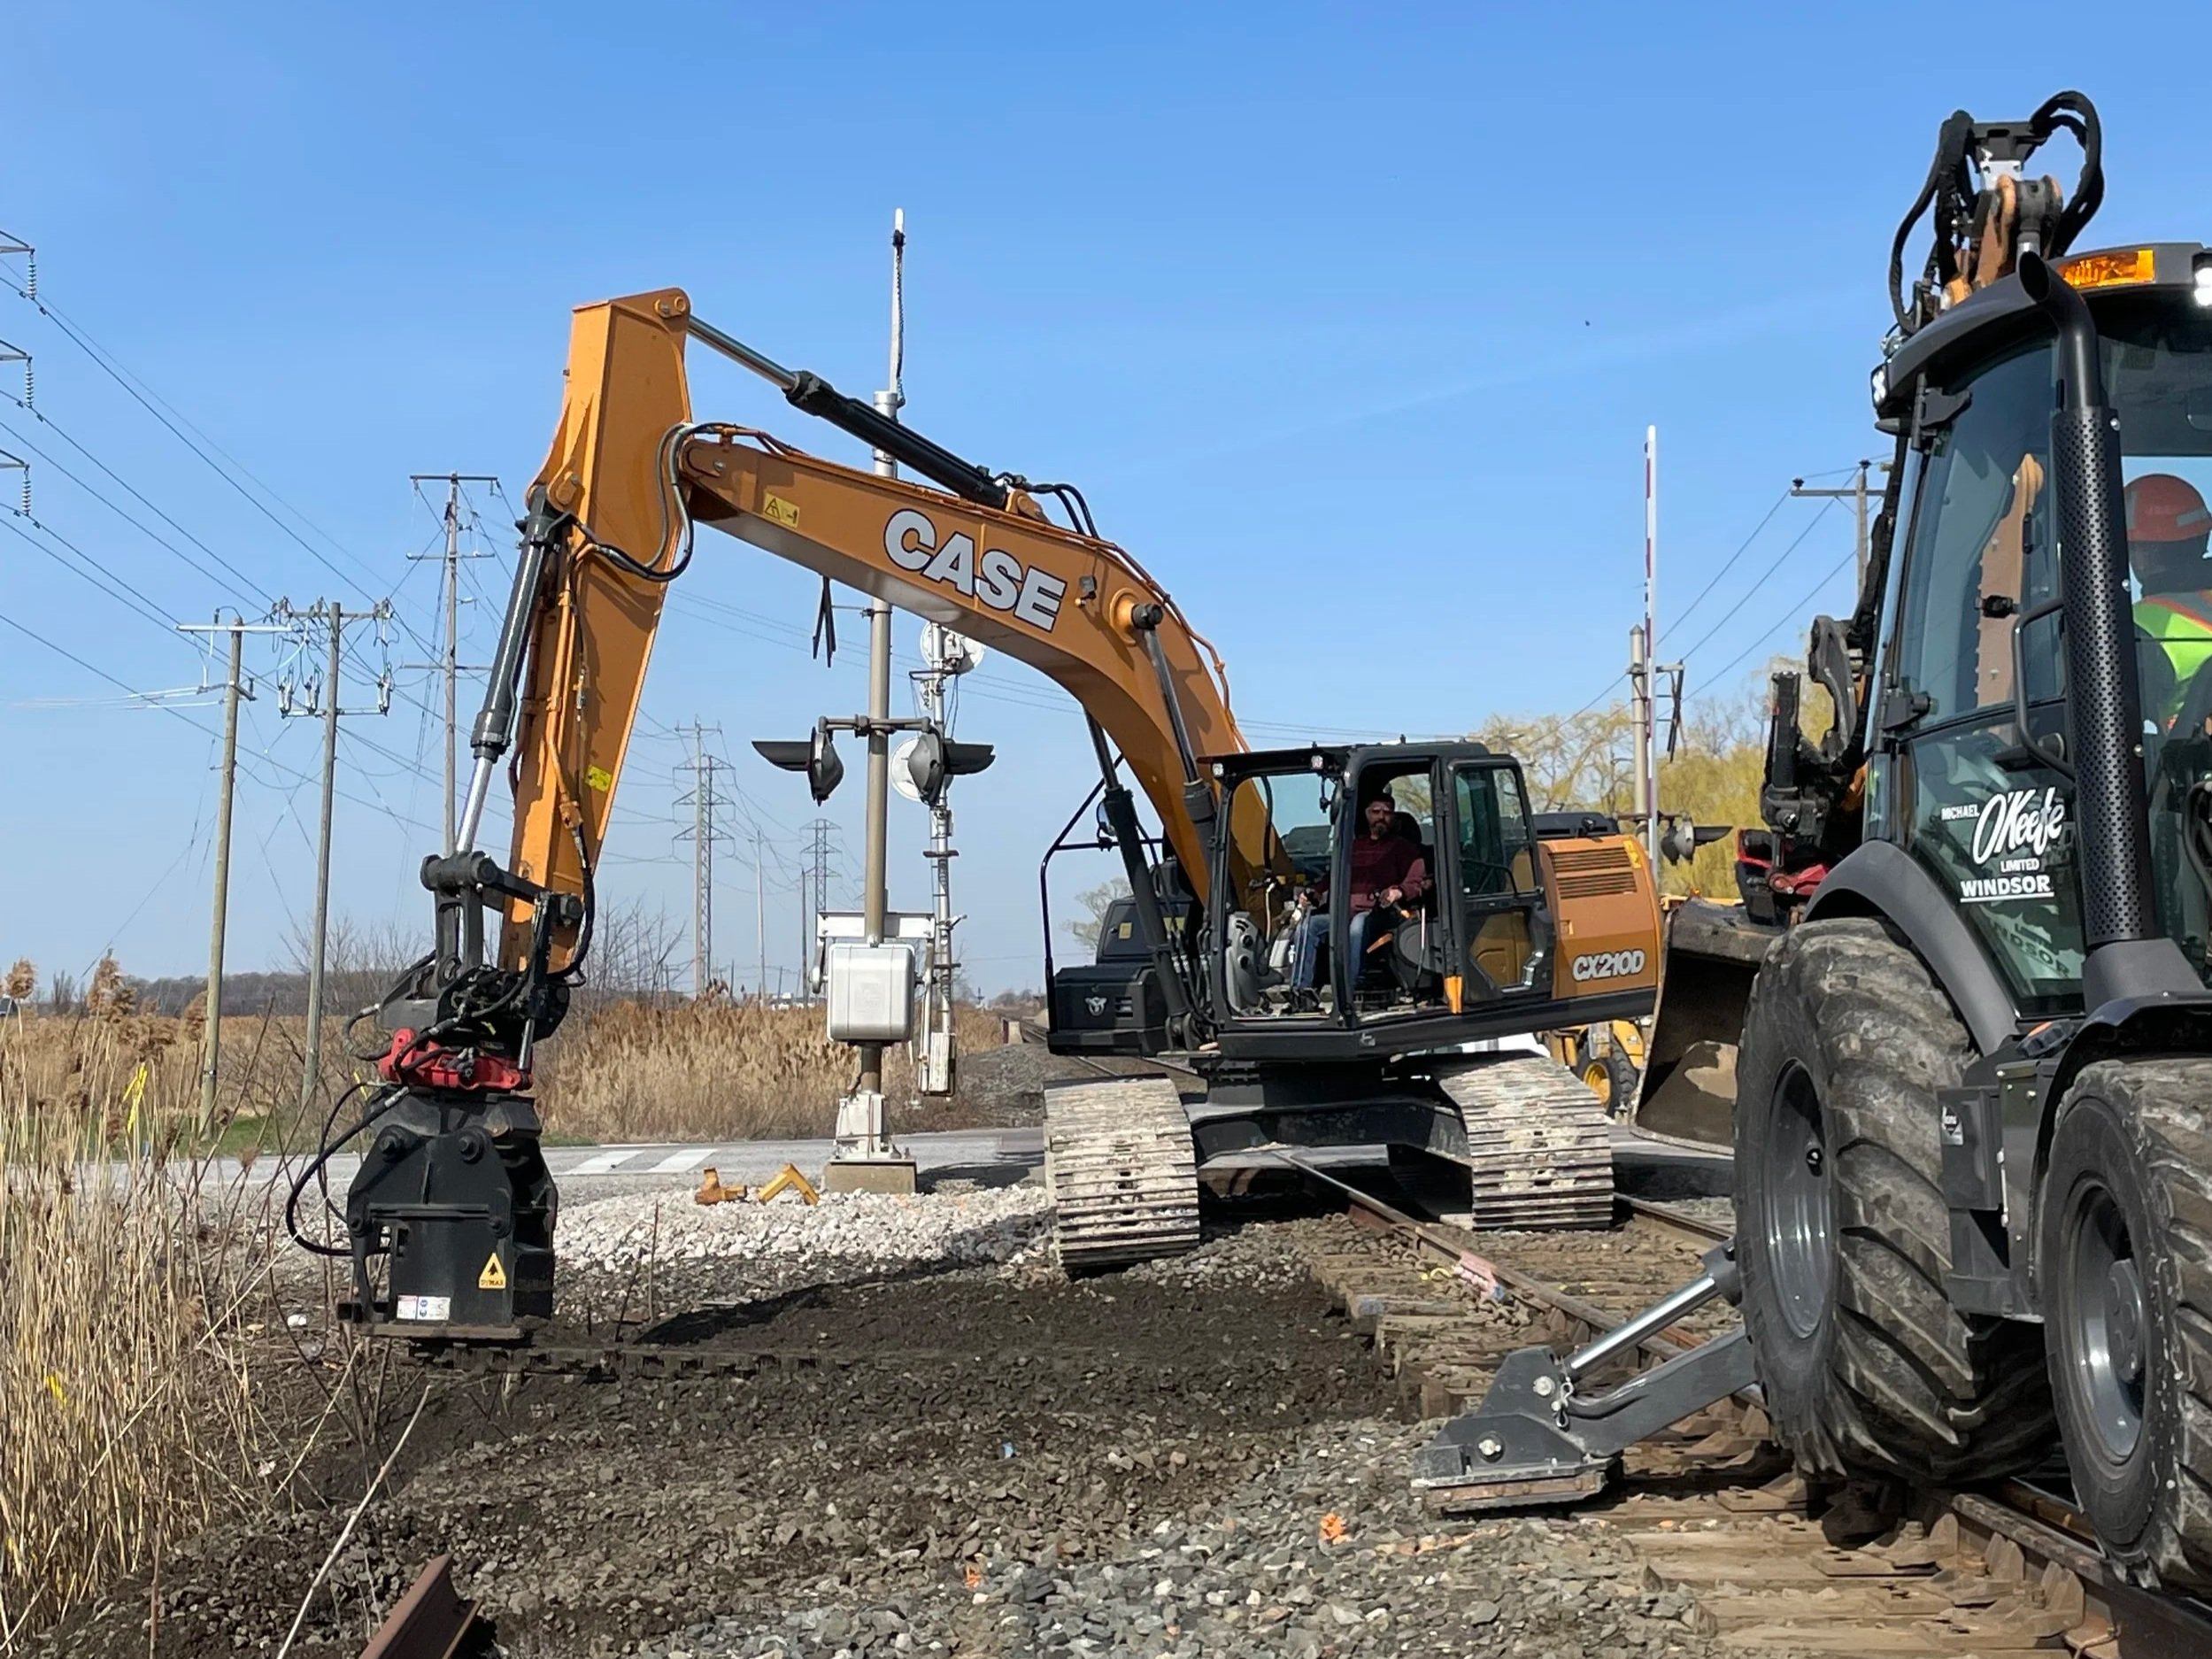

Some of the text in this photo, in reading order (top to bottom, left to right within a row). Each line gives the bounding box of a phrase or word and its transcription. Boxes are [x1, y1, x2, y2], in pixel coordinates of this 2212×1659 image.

[883, 508, 1067, 633] CASE
[1941, 786, 2065, 865] MICHAEL O'Keefe
[2000, 858, 2040, 873] LIMITED
[1960, 874, 2052, 898] WINDSOR
[1572, 949, 1646, 982] CX210D
